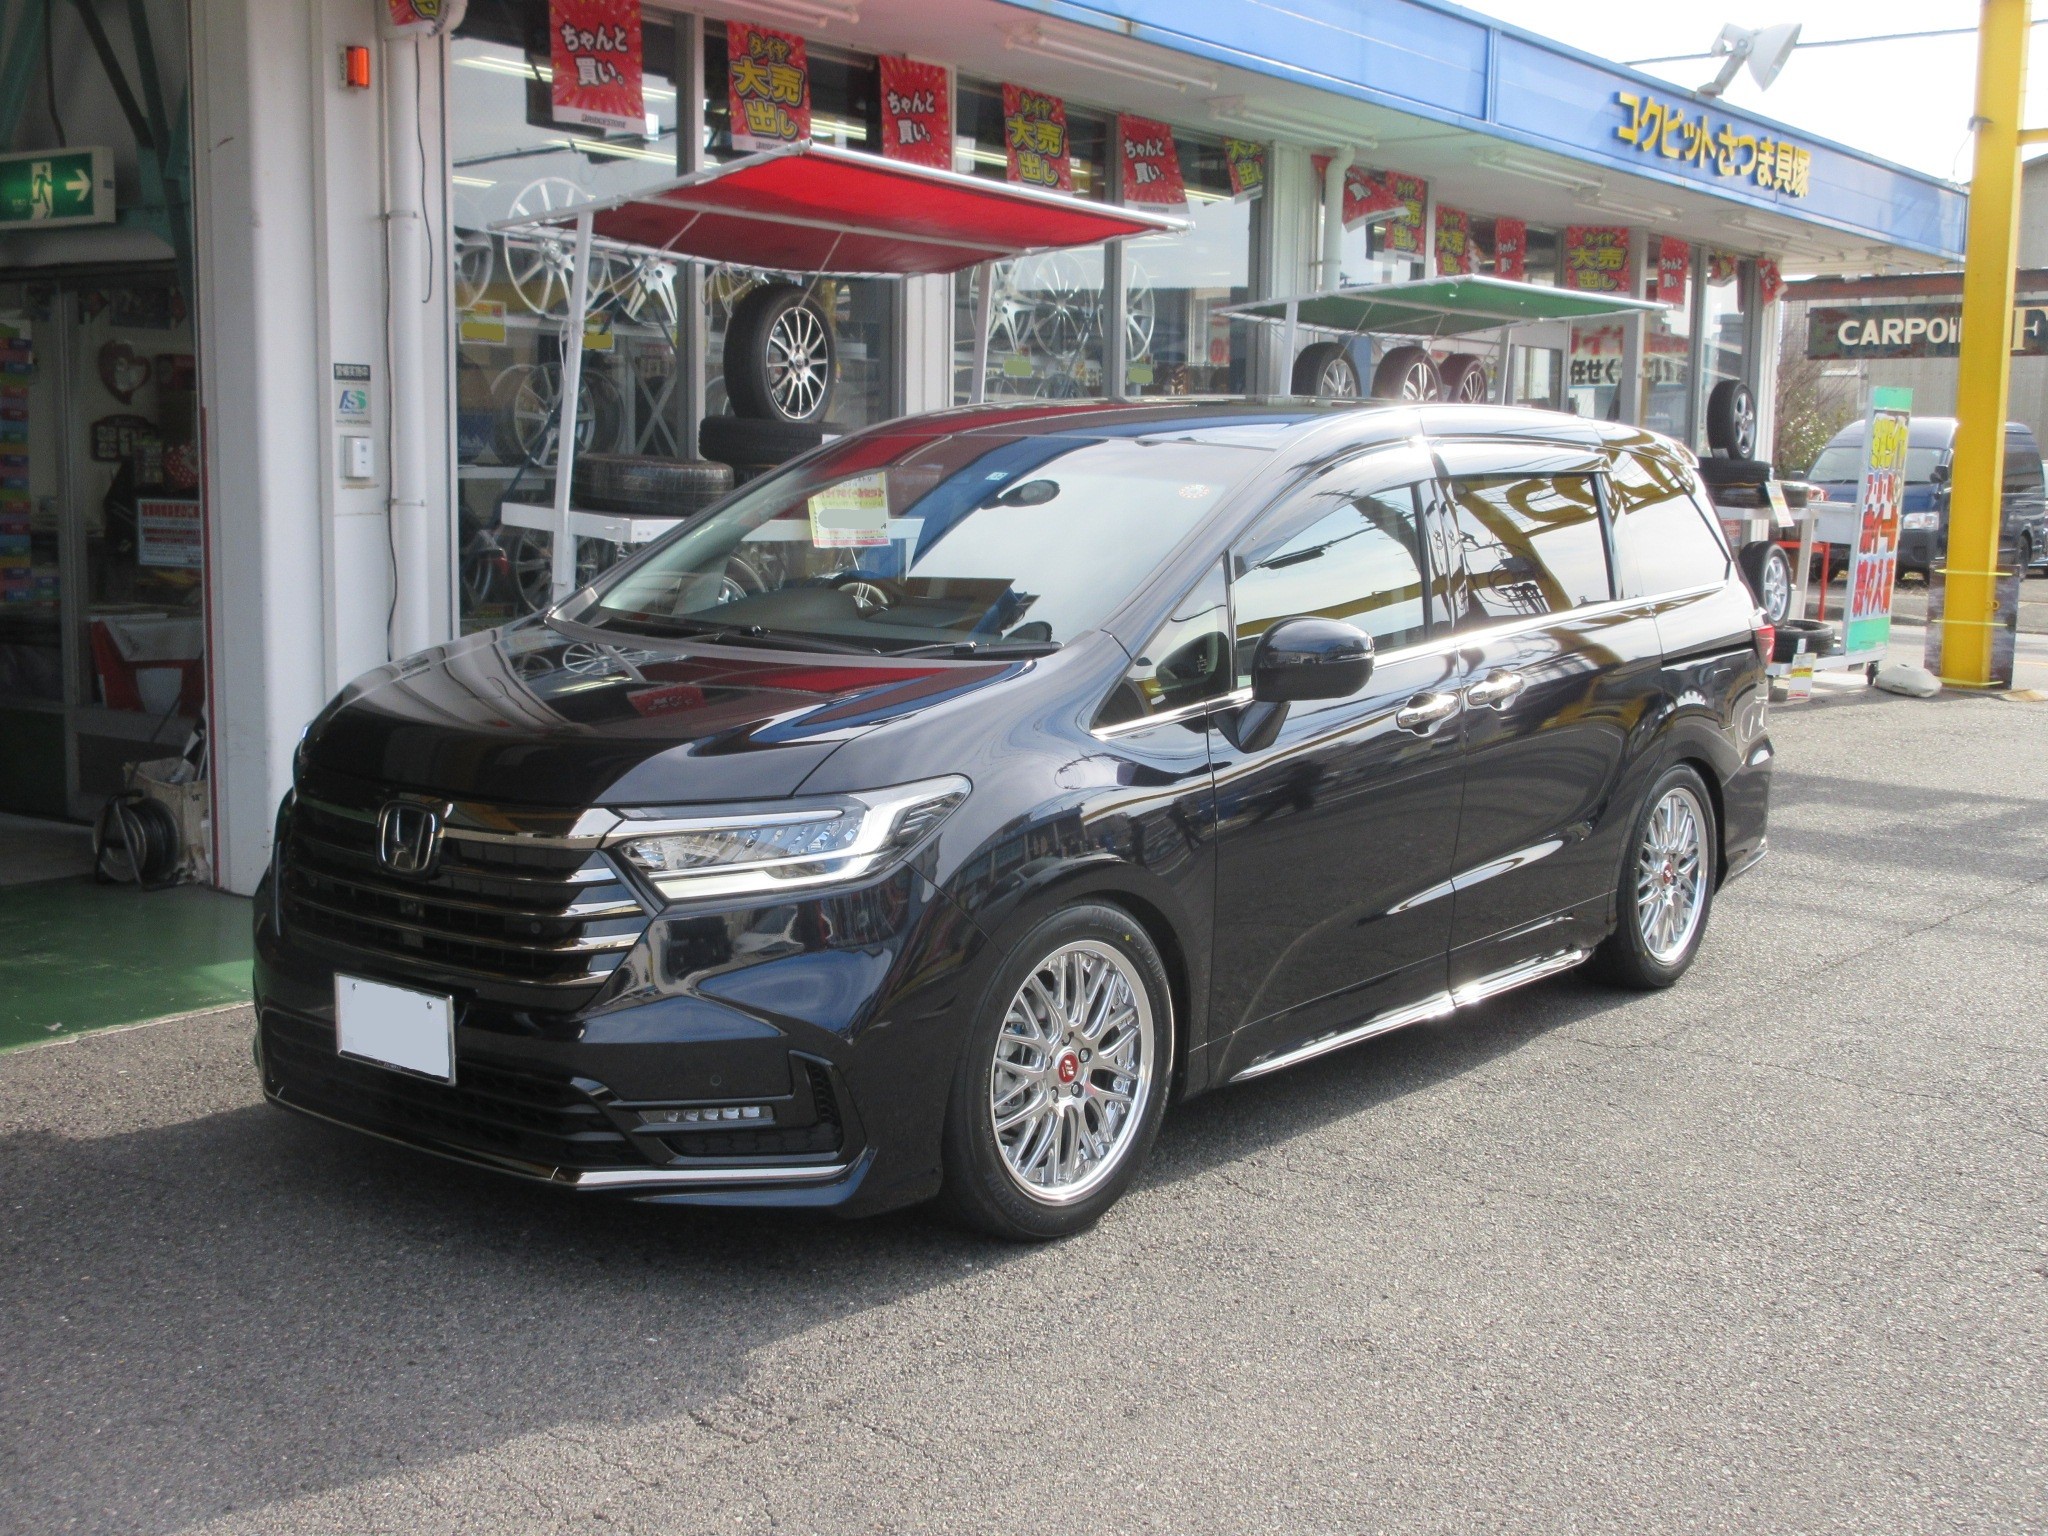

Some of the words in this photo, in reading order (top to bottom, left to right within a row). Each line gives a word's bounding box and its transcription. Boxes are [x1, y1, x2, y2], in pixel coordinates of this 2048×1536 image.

[561, 23, 628, 51] ちゃんと
[748, 31, 790, 60] タイヤ
[575, 56, 624, 86] 買い。
[730, 56, 804, 106] 大売
[887, 89, 935, 114] ちゃんと
[1021, 92, 1051, 120] タイヤ
[743, 98, 798, 139] 出し
[897, 119, 931, 144] 買い。
[1006, 113, 1064, 157] 大売
[1124, 138, 1165, 158] ちゃんと
[1616, 91, 1812, 198] コクピットさつま貝塚
[1018, 150, 1059, 186] 出し
[1584, 231, 1616, 247] タイヤ
[1568, 246, 1627, 271] 大売
[1577, 269, 1618, 291] 出し
